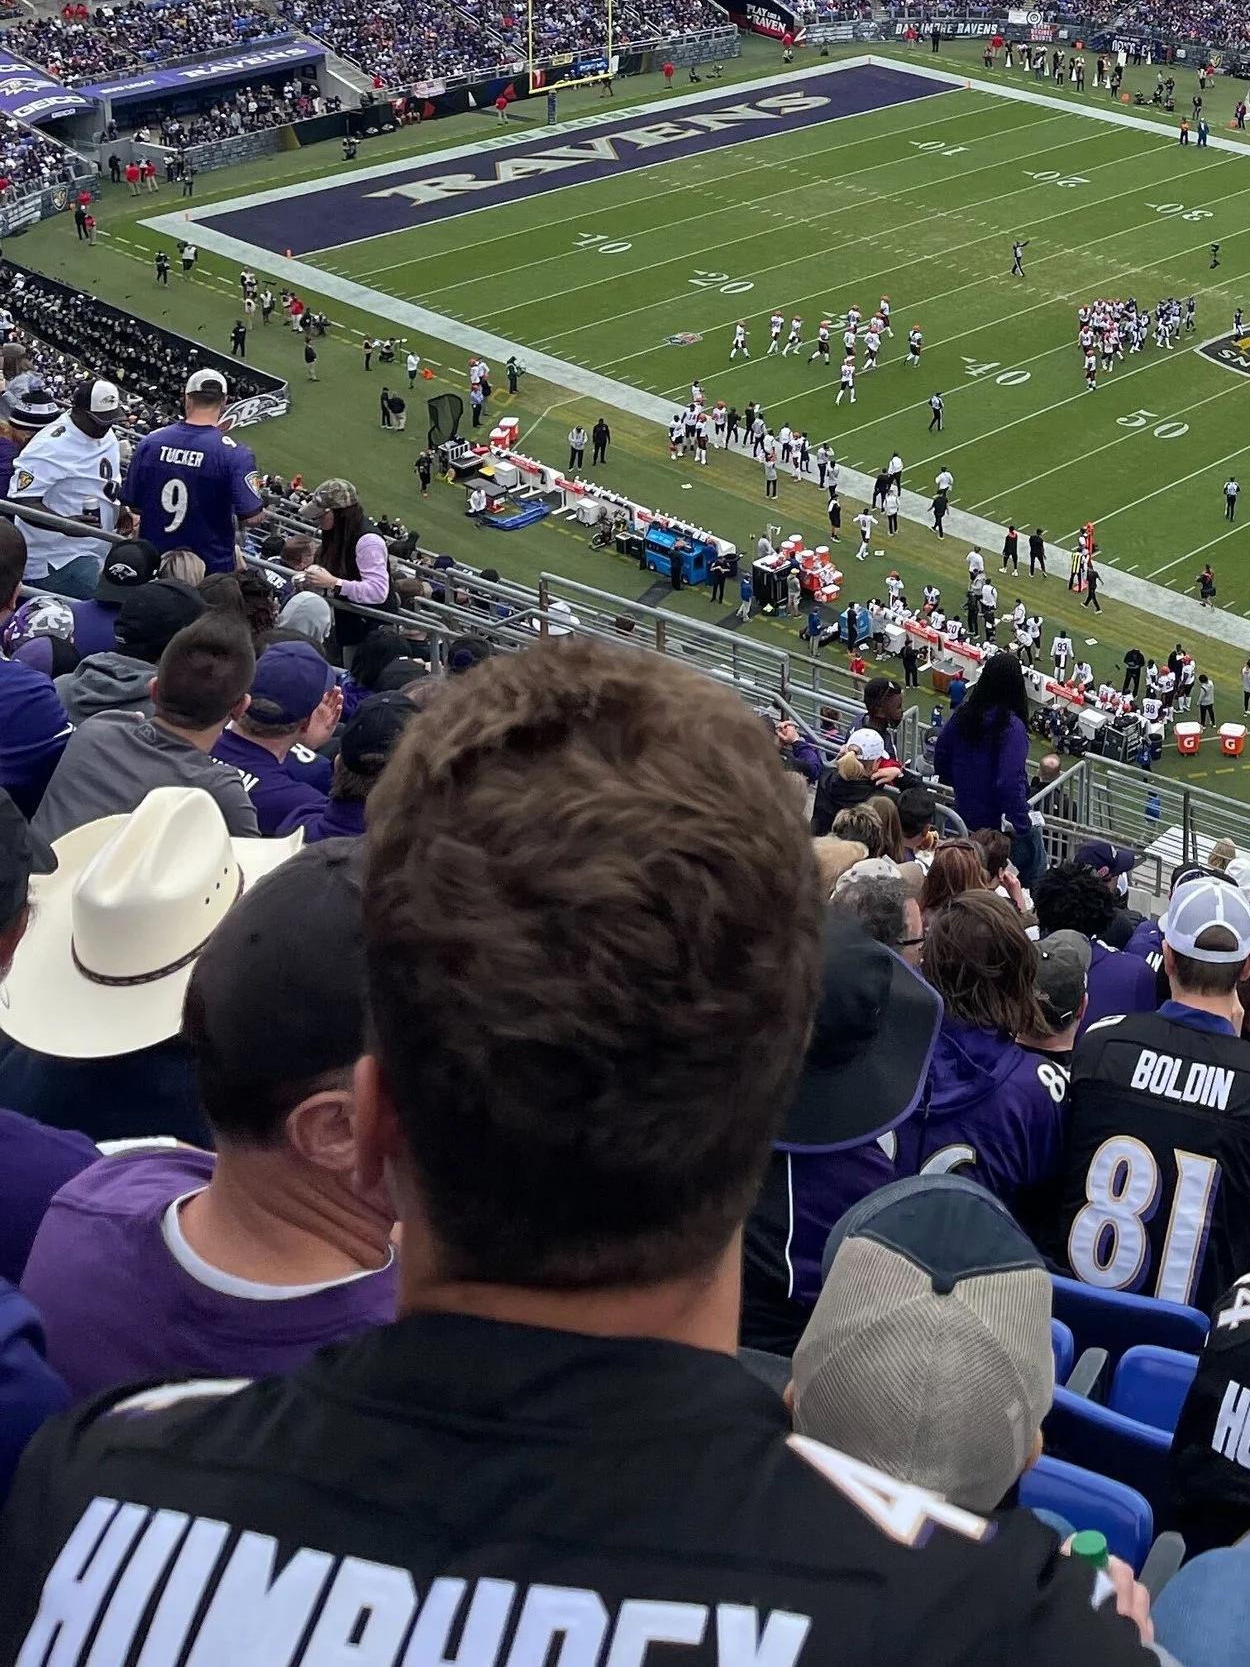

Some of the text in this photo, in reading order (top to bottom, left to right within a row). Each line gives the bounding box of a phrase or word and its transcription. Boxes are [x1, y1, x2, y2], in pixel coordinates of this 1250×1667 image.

[746, 4, 768, 17] PLAY
[752, 14, 786, 34] RAVEN
[956, 23, 998, 34] RAVENS
[178, 47, 308, 78] RAVENS
[12, 94, 87, 118] GEICO
[544, 105, 646, 136] RACISM
[361, 90, 832, 207] RAVENS
[920, 140, 970, 157] 10
[1032, 170, 1090, 189] 20
[1155, 202, 1214, 222] 30
[572, 232, 632, 254] 10
[688, 271, 754, 294] 20
[963, 360, 1031, 386] 40
[1116, 410, 1190, 439] 50
[221, 435, 238, 449] 9
[160, 445, 204, 467] TUCKER
[161, 478, 189, 533] 9
[948, 624, 958, 635] 70
[1057, 642, 1068, 652] 93
[1144, 704, 1155, 714] 98
[1183, 737, 1195, 748] G
[1225, 739, 1236, 750] G
[1130, 1050, 1235, 1111] BOLDIN
[1068, 1135, 1220, 1305] 81
